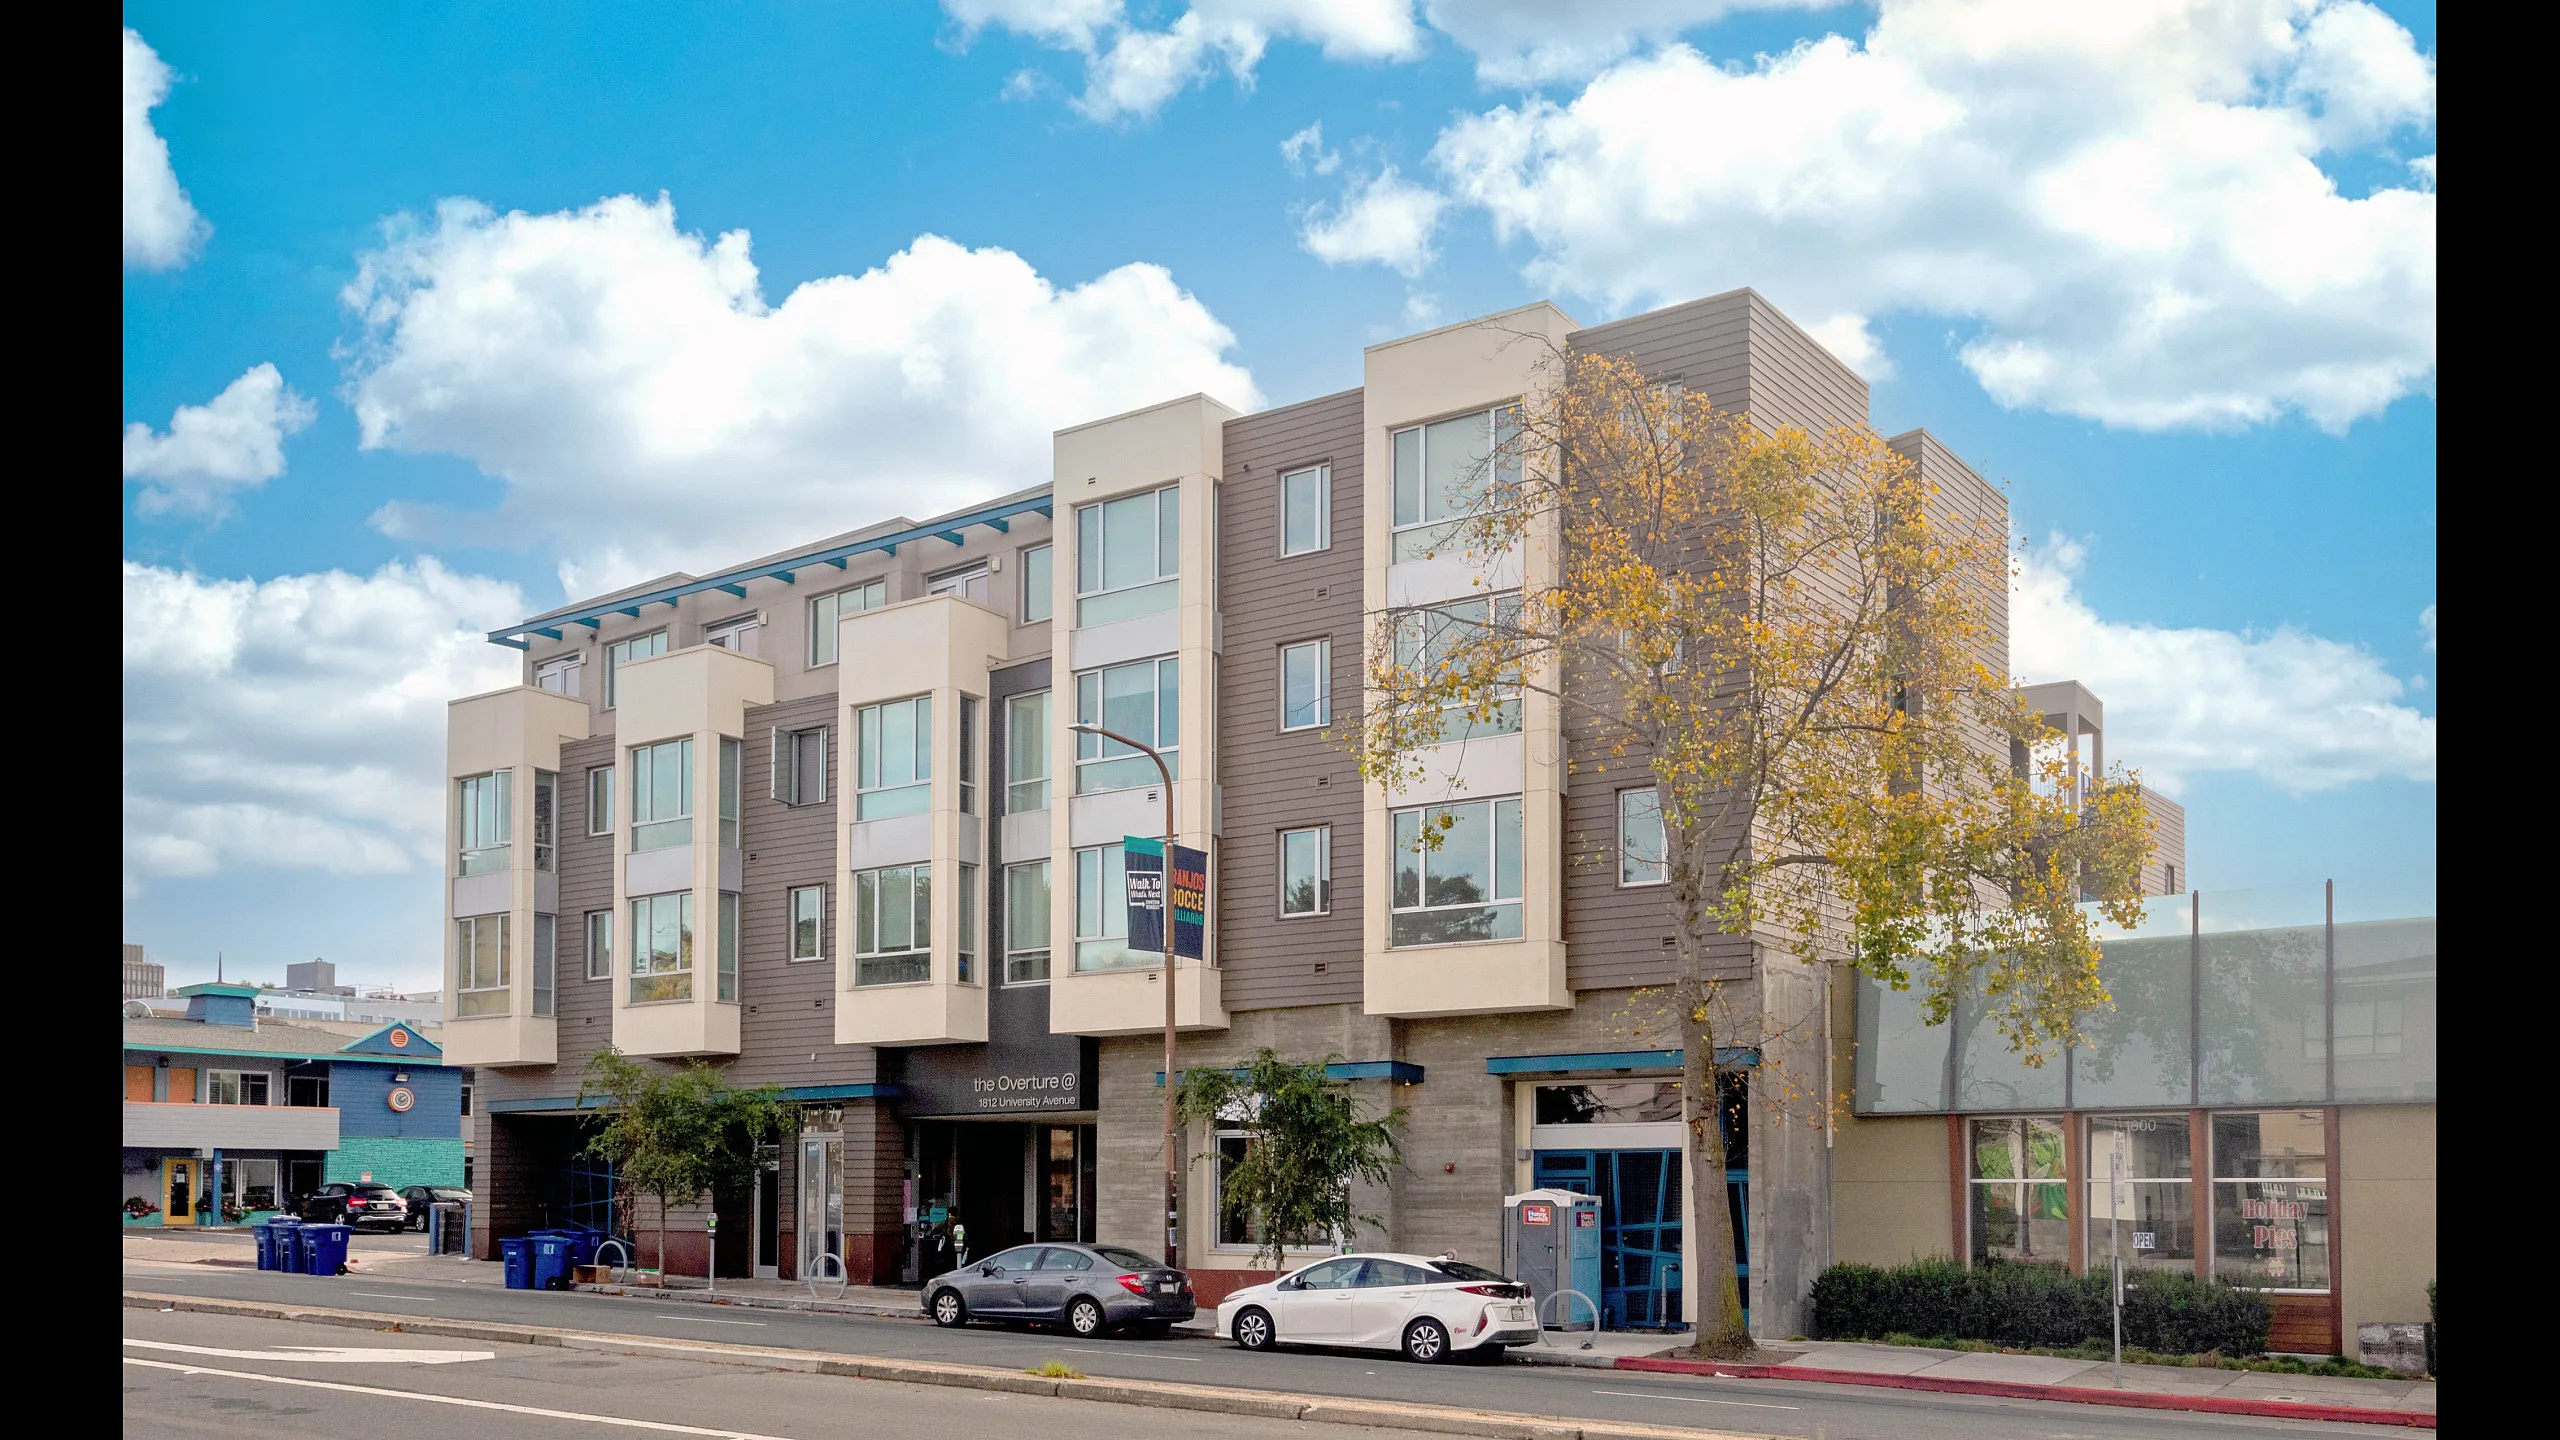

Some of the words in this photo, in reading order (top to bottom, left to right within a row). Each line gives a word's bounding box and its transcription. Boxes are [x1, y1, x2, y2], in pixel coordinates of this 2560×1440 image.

[1129, 878, 1151, 890] Walk
[1152, 878, 1161, 890] To
[1148, 890, 1161, 898] Next
[1174, 908, 1204, 926] ILLIARDS
[974, 1077, 996, 1092] the
[998, 1075, 1060, 1091] Overture
[1061, 1072, 1076, 1091] @
[979, 1097, 998, 1108] 1812
[999, 1096, 1042, 1108] University
[1043, 1095, 1076, 1106] Avenue
[2242, 1195, 2309, 1222] Holiday
[2133, 1233, 2154, 1248] OPEN
[2253, 1225, 2298, 1250] Pies
